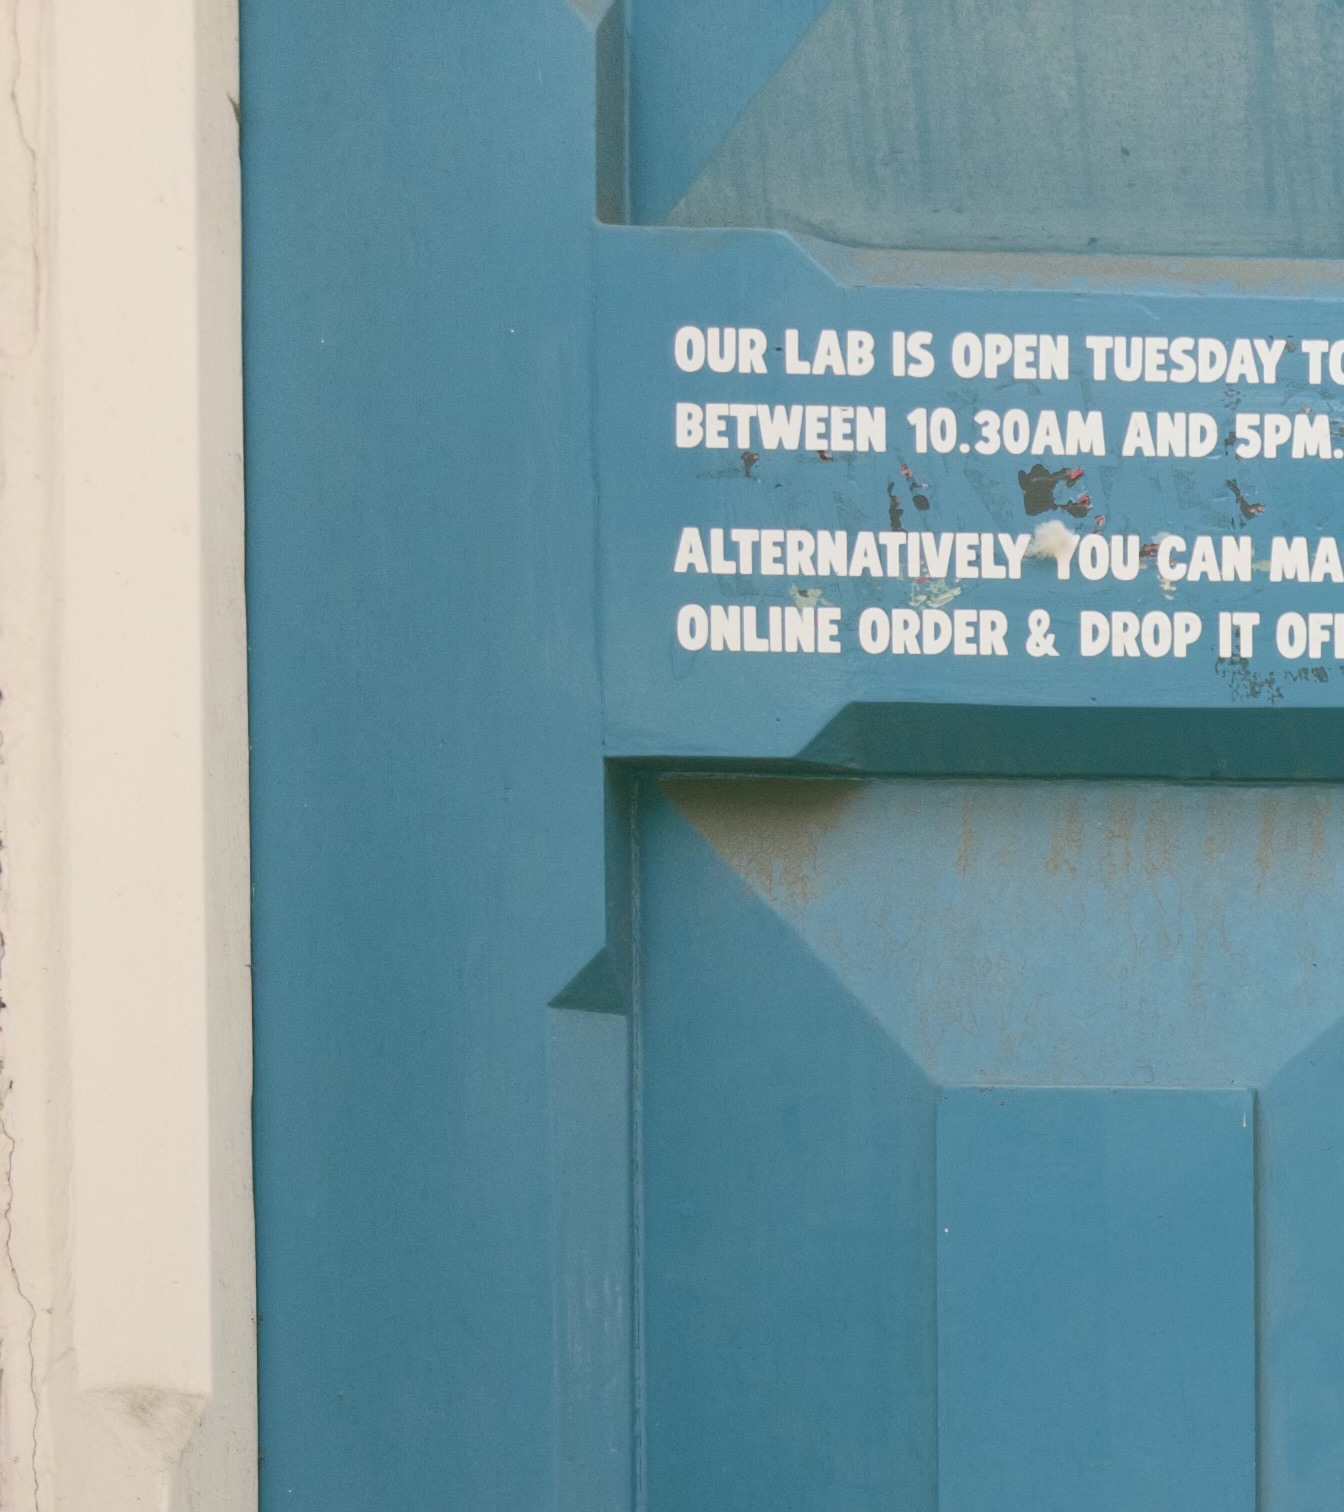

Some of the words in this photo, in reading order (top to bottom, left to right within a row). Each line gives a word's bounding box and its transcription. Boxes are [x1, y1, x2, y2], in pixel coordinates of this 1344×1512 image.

[673, 325, 768, 375] OUR
[784, 328, 876, 377] LAB
[891, 331, 936, 379] IS
[951, 332, 1071, 382] OPEN
[1085, 335, 1287, 385] TUESDAY
[674, 402, 887, 453] BETWEEN
[906, 406, 1106, 457] 10.30AM
[1121, 410, 1218, 459] AND
[1234, 412, 1344, 460] 5PM.
[673, 526, 1032, 580] ALTERNATIVELY
[1048, 532, 1140, 582] YOU
[1156, 534, 1252, 583] CAN
[675, 604, 842, 655] ONLINE
[857, 608, 1009, 657] ORDER
[1025, 608, 1060, 658] &
[1080, 610, 1202, 659] DROP
[1218, 611, 1261, 660] IT
